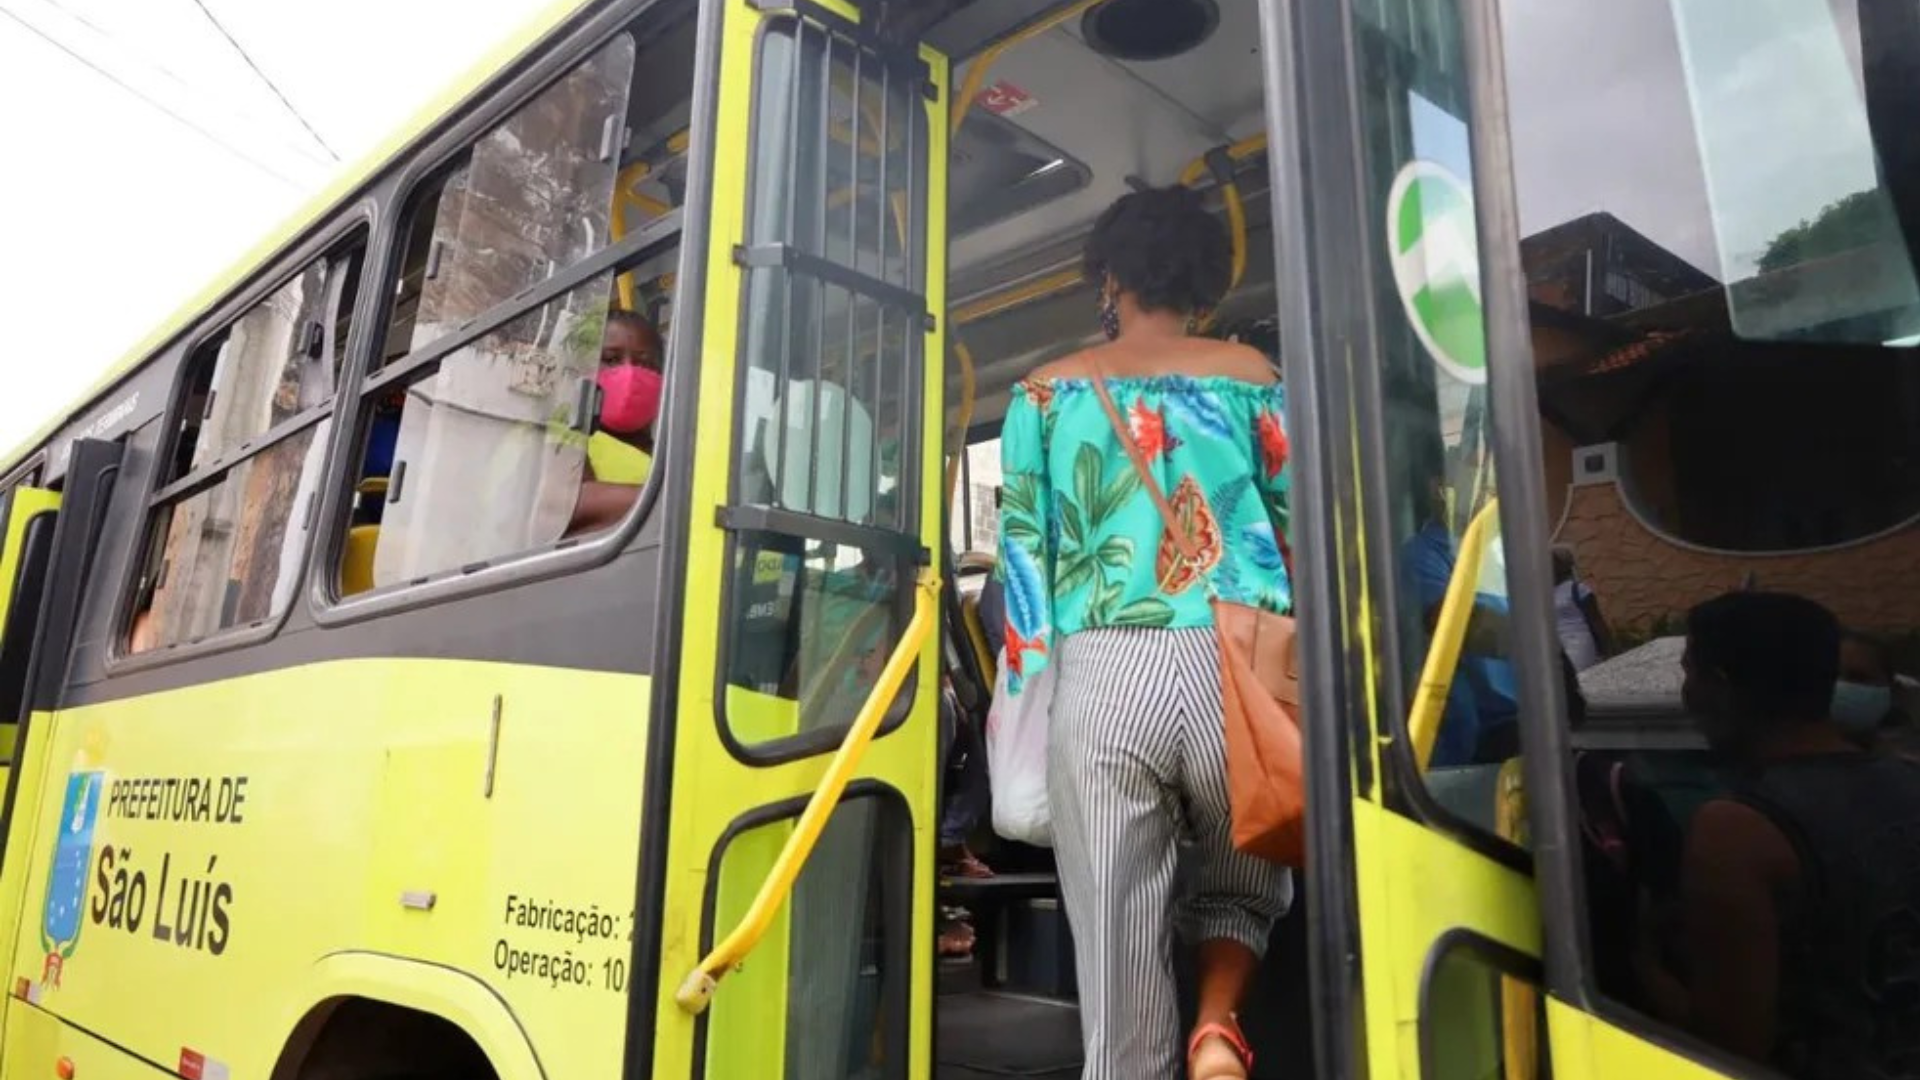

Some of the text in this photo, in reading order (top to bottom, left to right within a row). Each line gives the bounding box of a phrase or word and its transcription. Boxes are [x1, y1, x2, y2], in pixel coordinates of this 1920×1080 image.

[108, 776, 248, 823] PREFEITURA DE
[91, 844, 232, 956] São Luís
[505, 894, 621, 943] Fabricação:
[494, 938, 593, 988] Operação:
